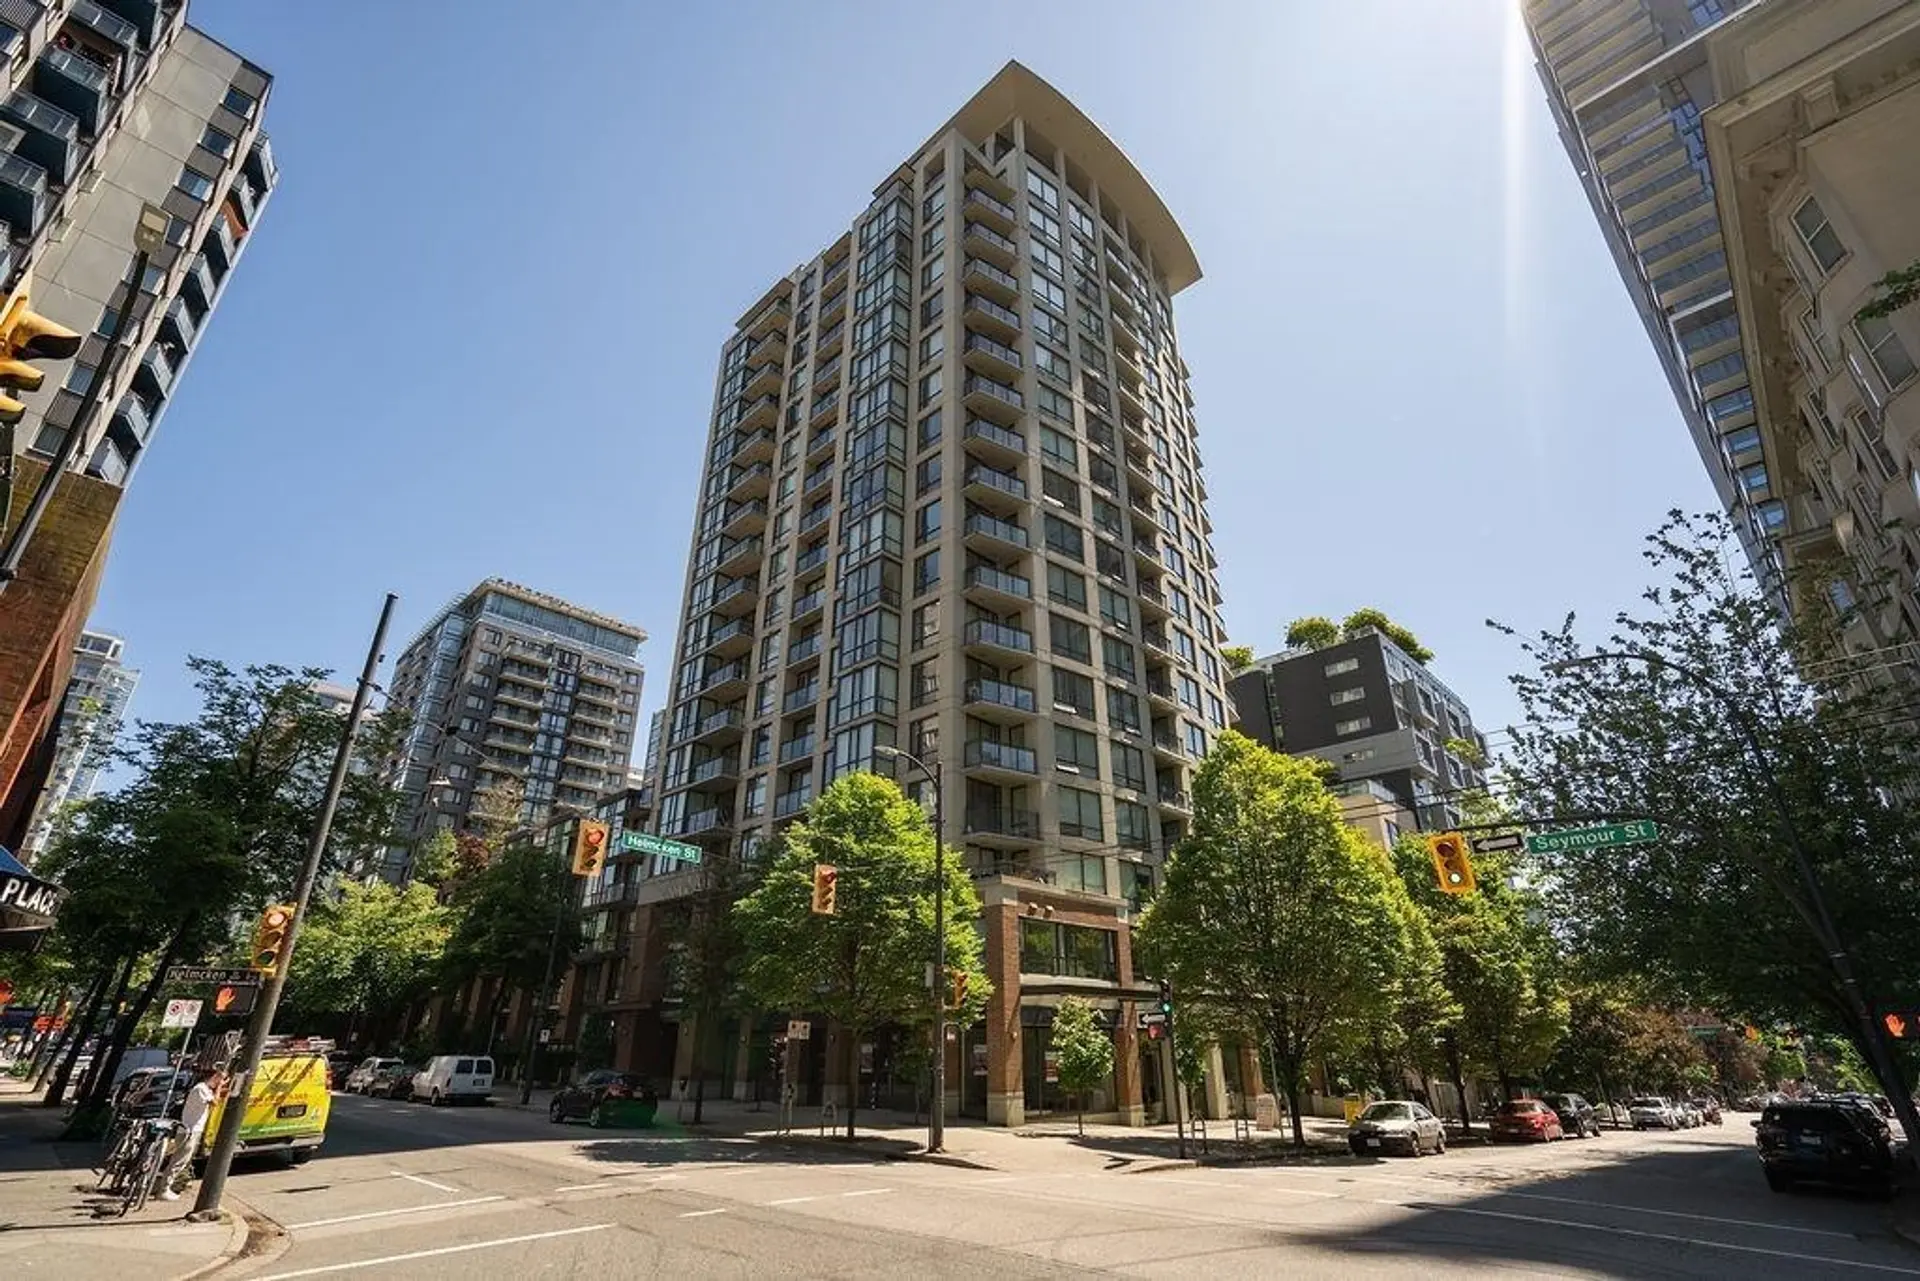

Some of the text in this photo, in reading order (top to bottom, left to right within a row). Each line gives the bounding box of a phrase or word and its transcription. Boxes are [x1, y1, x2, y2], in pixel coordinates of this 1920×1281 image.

[627, 836, 697, 859] Helmcken St
[1536, 824, 1648, 851] Seymour St
